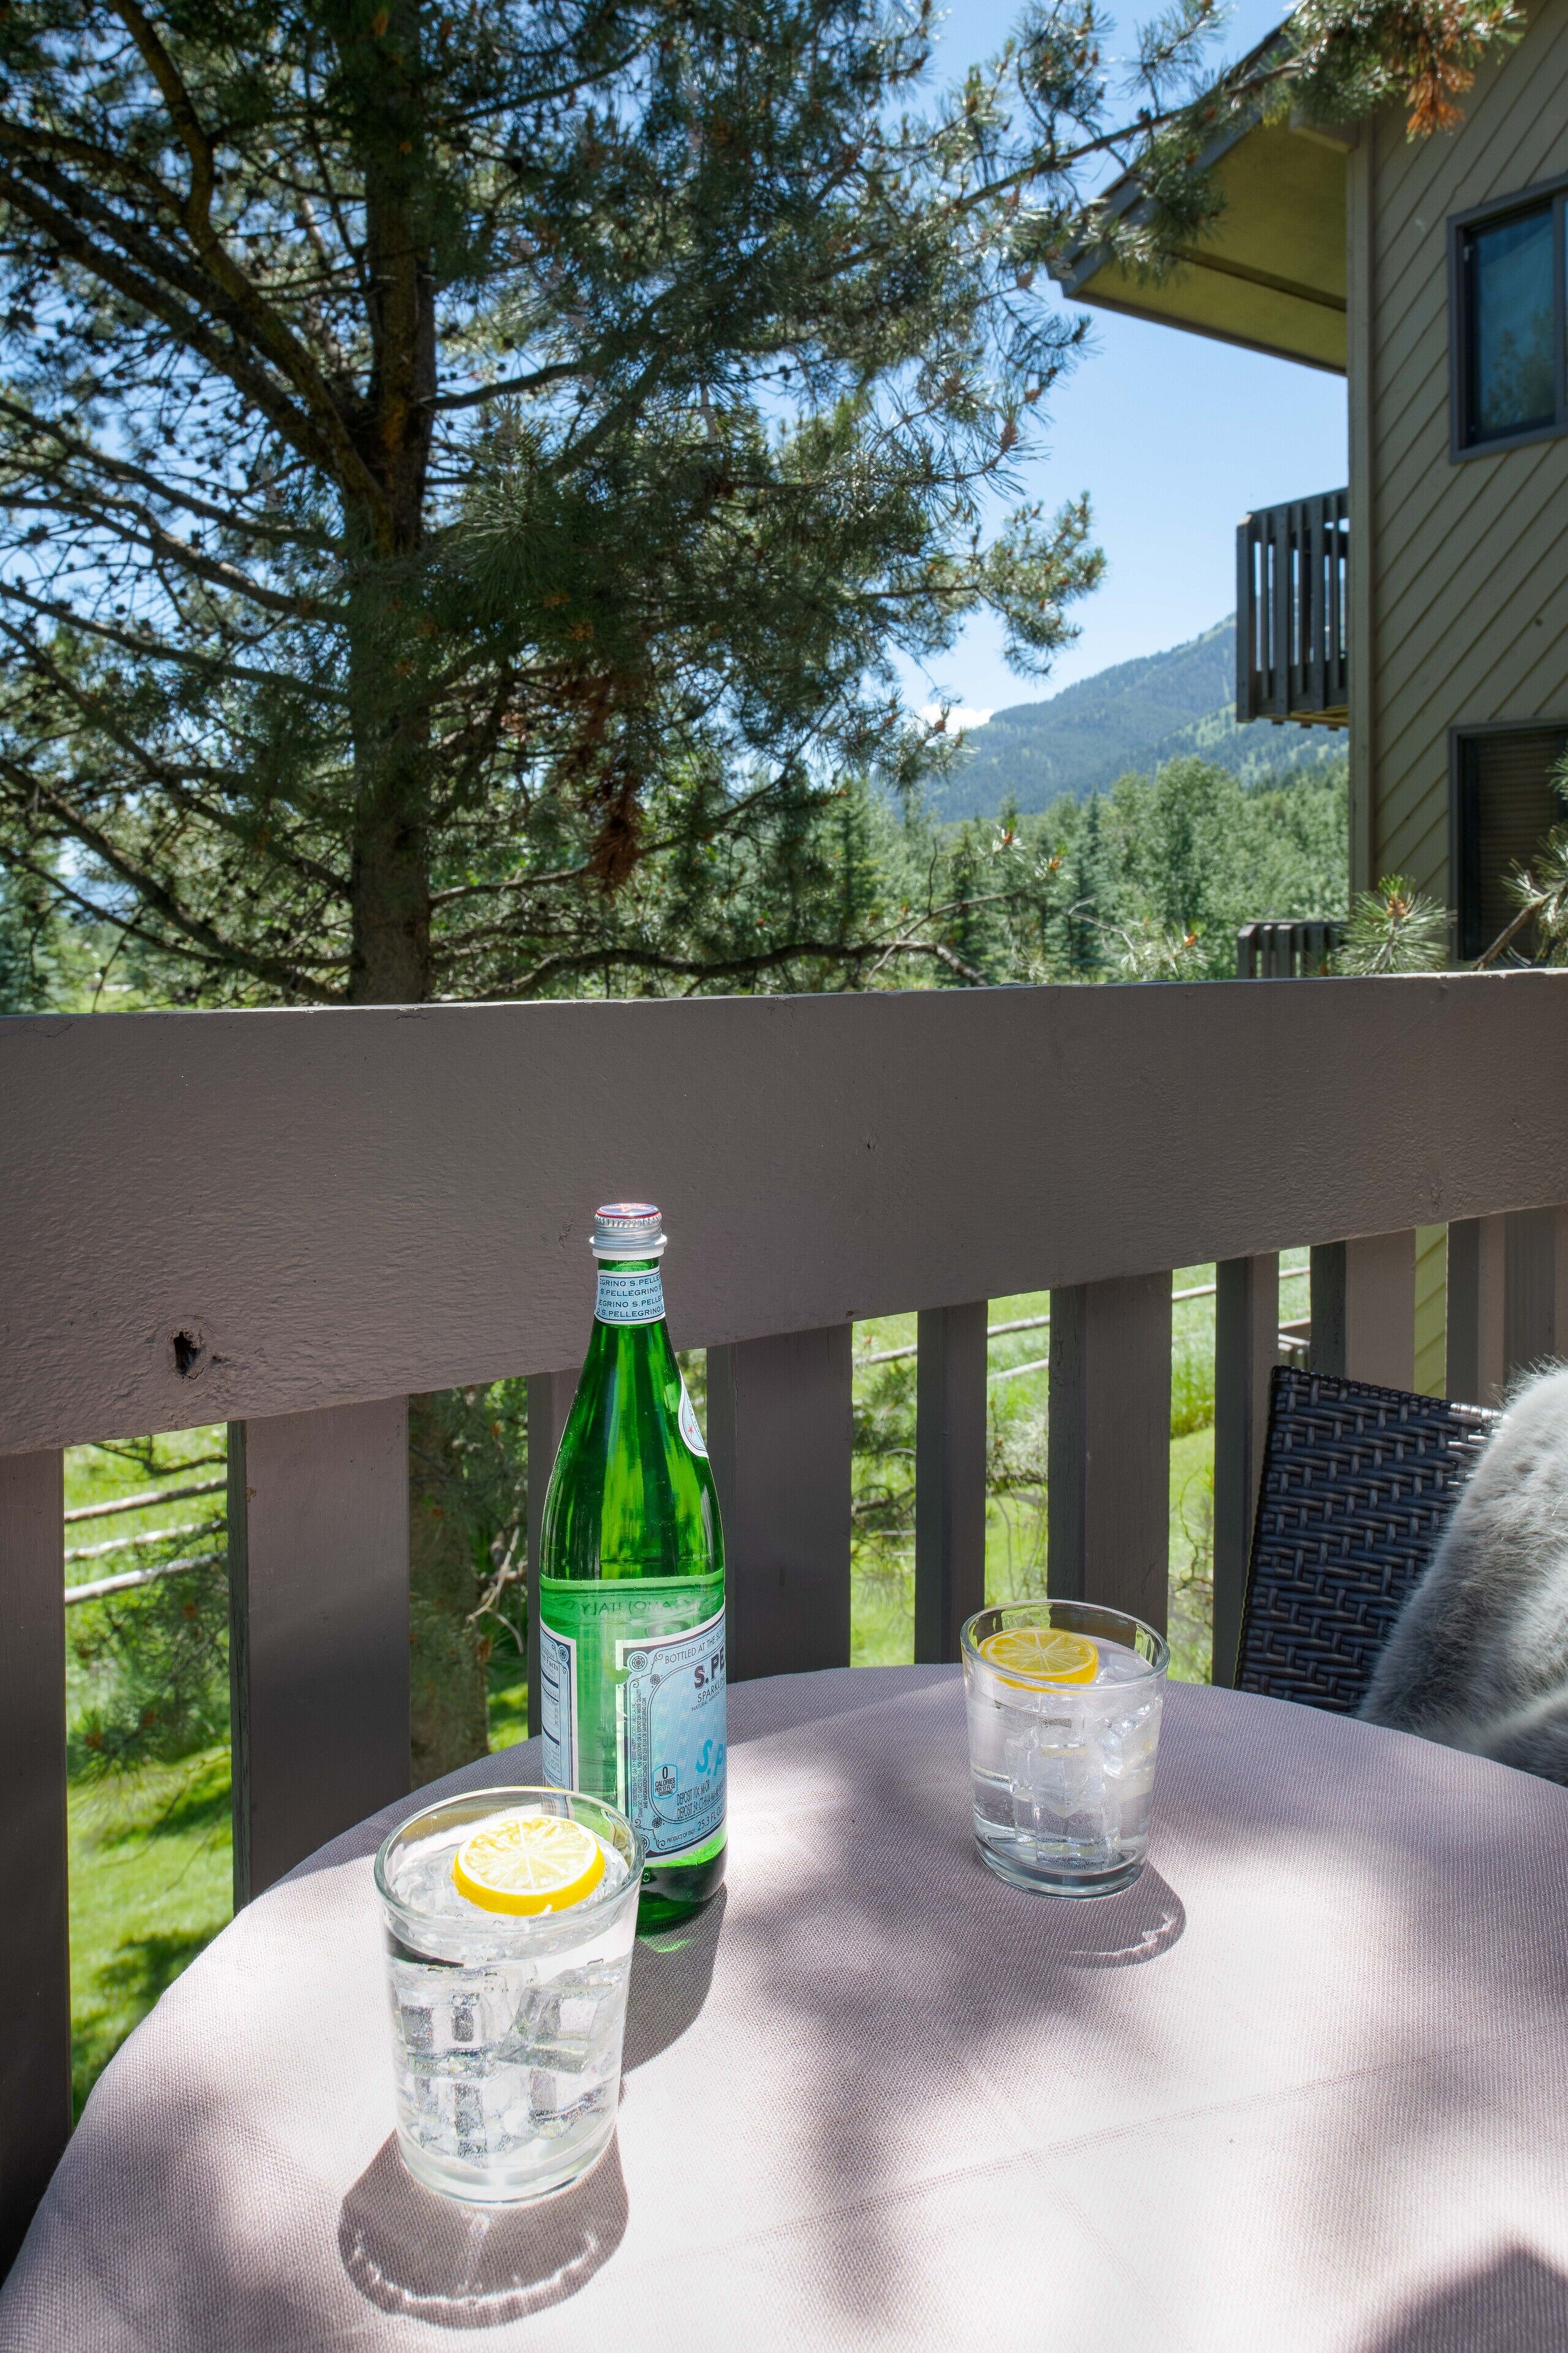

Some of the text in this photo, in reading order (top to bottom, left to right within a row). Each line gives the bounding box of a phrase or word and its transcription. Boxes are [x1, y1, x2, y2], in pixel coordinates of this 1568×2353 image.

[600, 1286, 658, 1296] S.PELLEGRINO
[598, 1295, 662, 1308] EGRINO S.PELLE
[601, 1306, 661, 1317] S.PELLEGRINO
[665, 1647, 696, 1664] BOTTLED
[699, 1642, 705, 1653] AT
[691, 1700, 708, 1711] NATURAL
[662, 1766, 668, 1779] 0
[655, 1777, 675, 1787] CALORIES
[677, 1789, 692, 1806] DEPOSIT
[678, 1803, 692, 1819] DEPOSIT
[667, 1833, 683, 1843] PRODUCT
[698, 1816, 710, 1831] 25.3
[711, 1811, 716, 1822] FL
[717, 1803, 722, 1816] OZ
